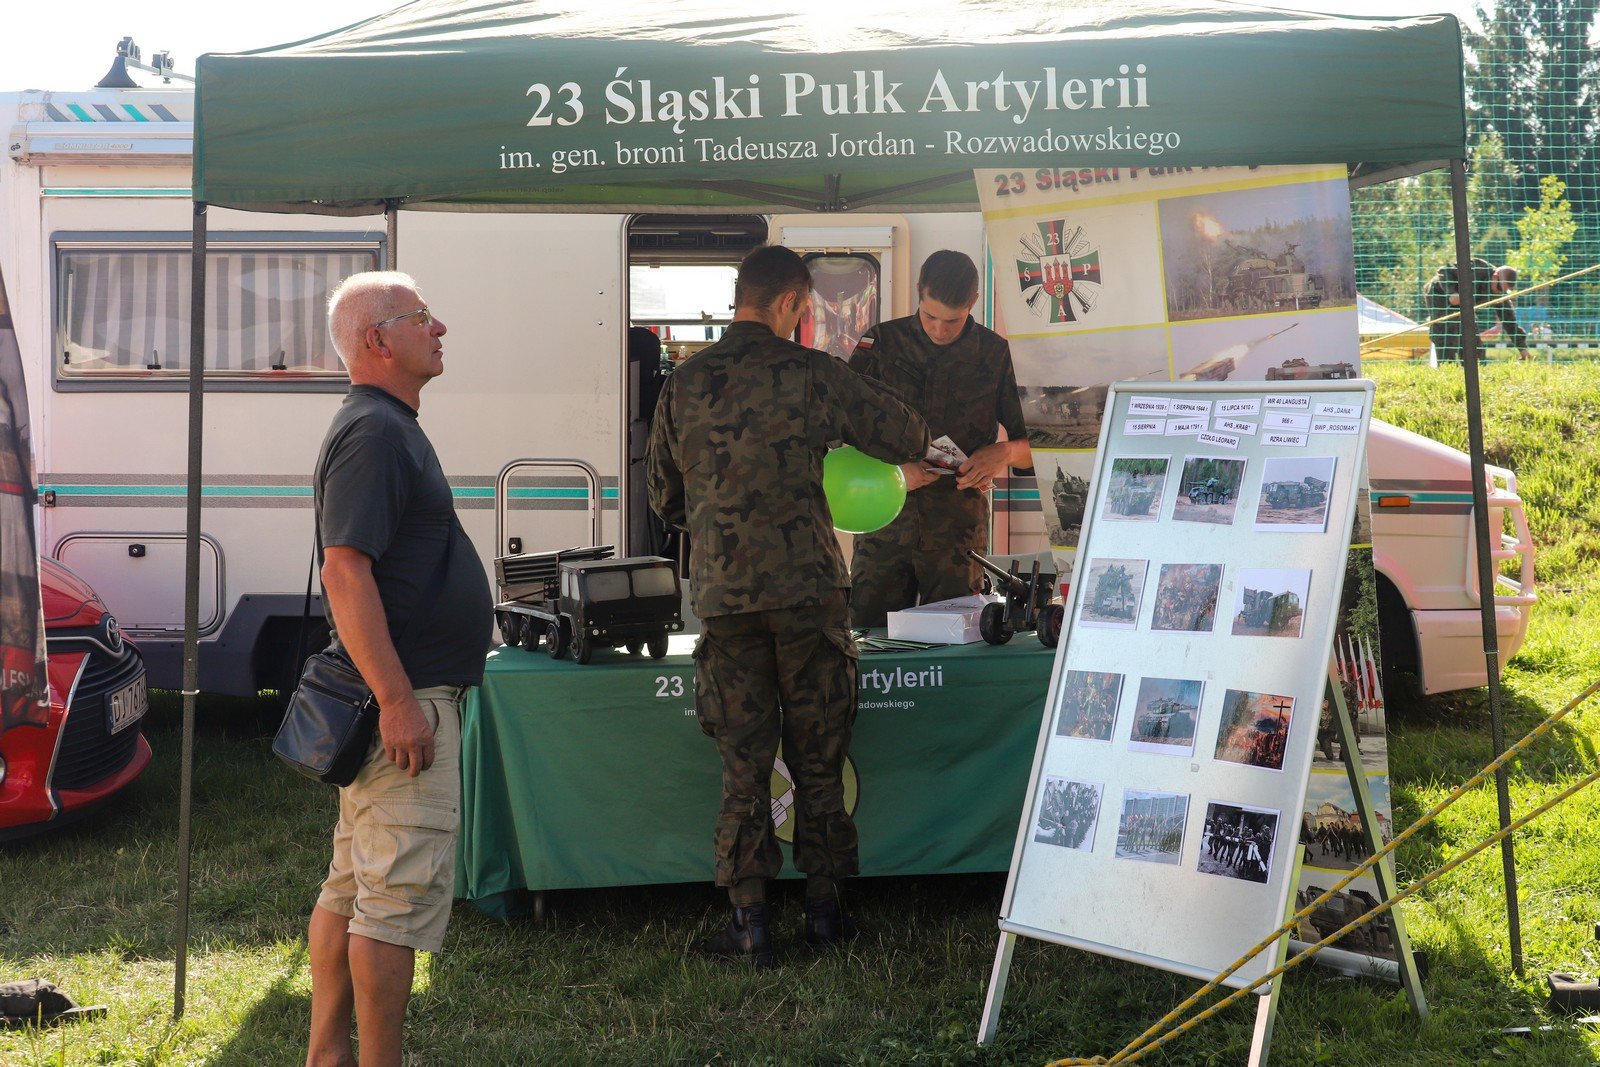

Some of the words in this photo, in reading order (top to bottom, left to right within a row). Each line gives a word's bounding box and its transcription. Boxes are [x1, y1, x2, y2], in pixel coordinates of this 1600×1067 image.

[526, 81, 584, 127] 23
[605, 66, 764, 135] Śląski
[779, 69, 906, 117] Pułk
[917, 63, 1150, 125] Artylerii
[499, 145, 541, 169] im.
[551, 149, 606, 174] gen.
[614, 138, 686, 165] broni
[693, 136, 819, 162] Tadeusza
[827, 131, 916, 158] Jordan
[943, 125, 1181, 156] Rozwadowskiego
[994, 171, 1026, 197] 23
[1046, 232, 1060, 246] 23
[1082, 263, 1092, 276] P
[1057, 304, 1067, 317] A
[1223, 421, 1234, 429] AHS
[1215, 436, 1237, 446] LEOPARD
[655, 675, 684, 697] 23
[859, 665, 943, 694] rtylerii
[859, 700, 915, 709] adowskiego
